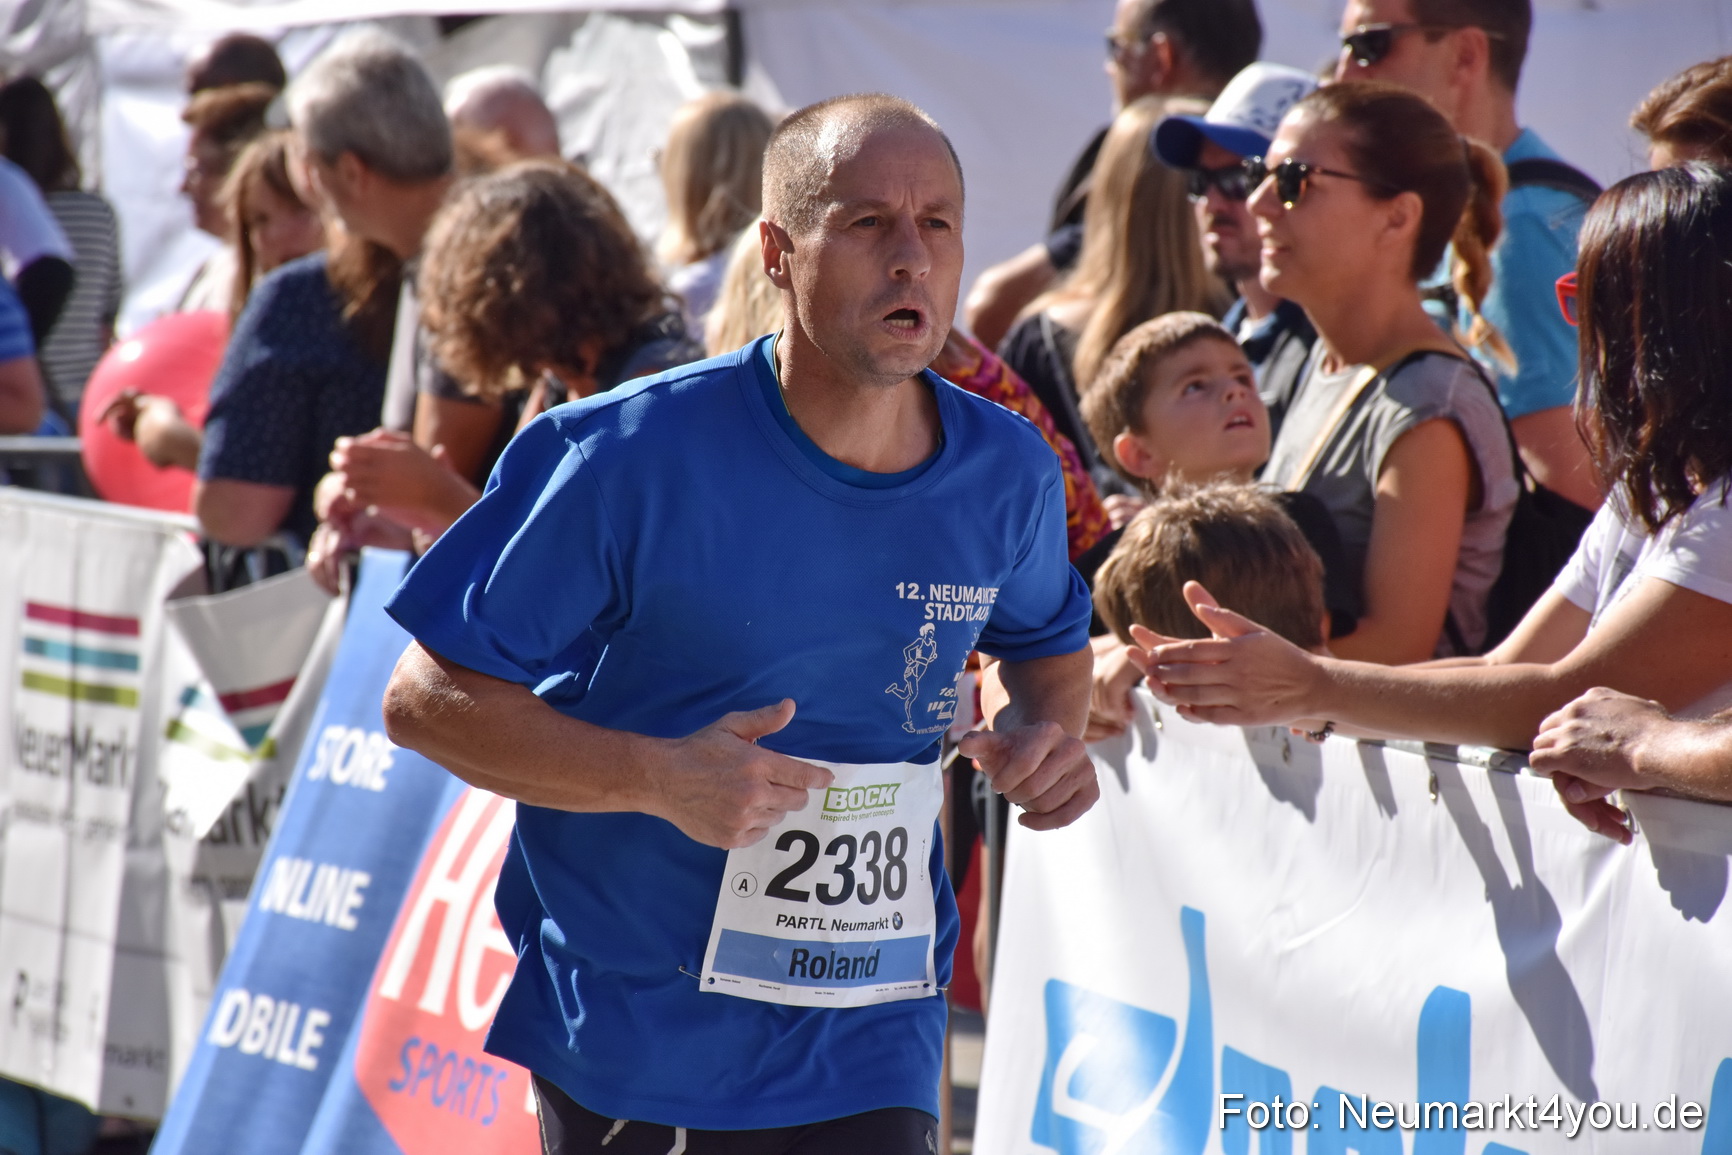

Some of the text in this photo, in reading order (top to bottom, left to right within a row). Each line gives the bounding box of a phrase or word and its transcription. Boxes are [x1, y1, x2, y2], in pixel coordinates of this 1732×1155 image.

[895, 582, 926, 600] 12.
[308, 726, 398, 792] STORE
[823, 782, 902, 813] BOCK
[820, 808, 896, 823] inspired by smart concepts
[764, 826, 909, 906] 2338
[258, 856, 371, 931] NLINE
[738, 879, 748, 892] A
[776, 914, 889, 932] PARTL Neumarkt
[788, 948, 880, 980] Roland
[389, 1035, 507, 1127] SPORTS
